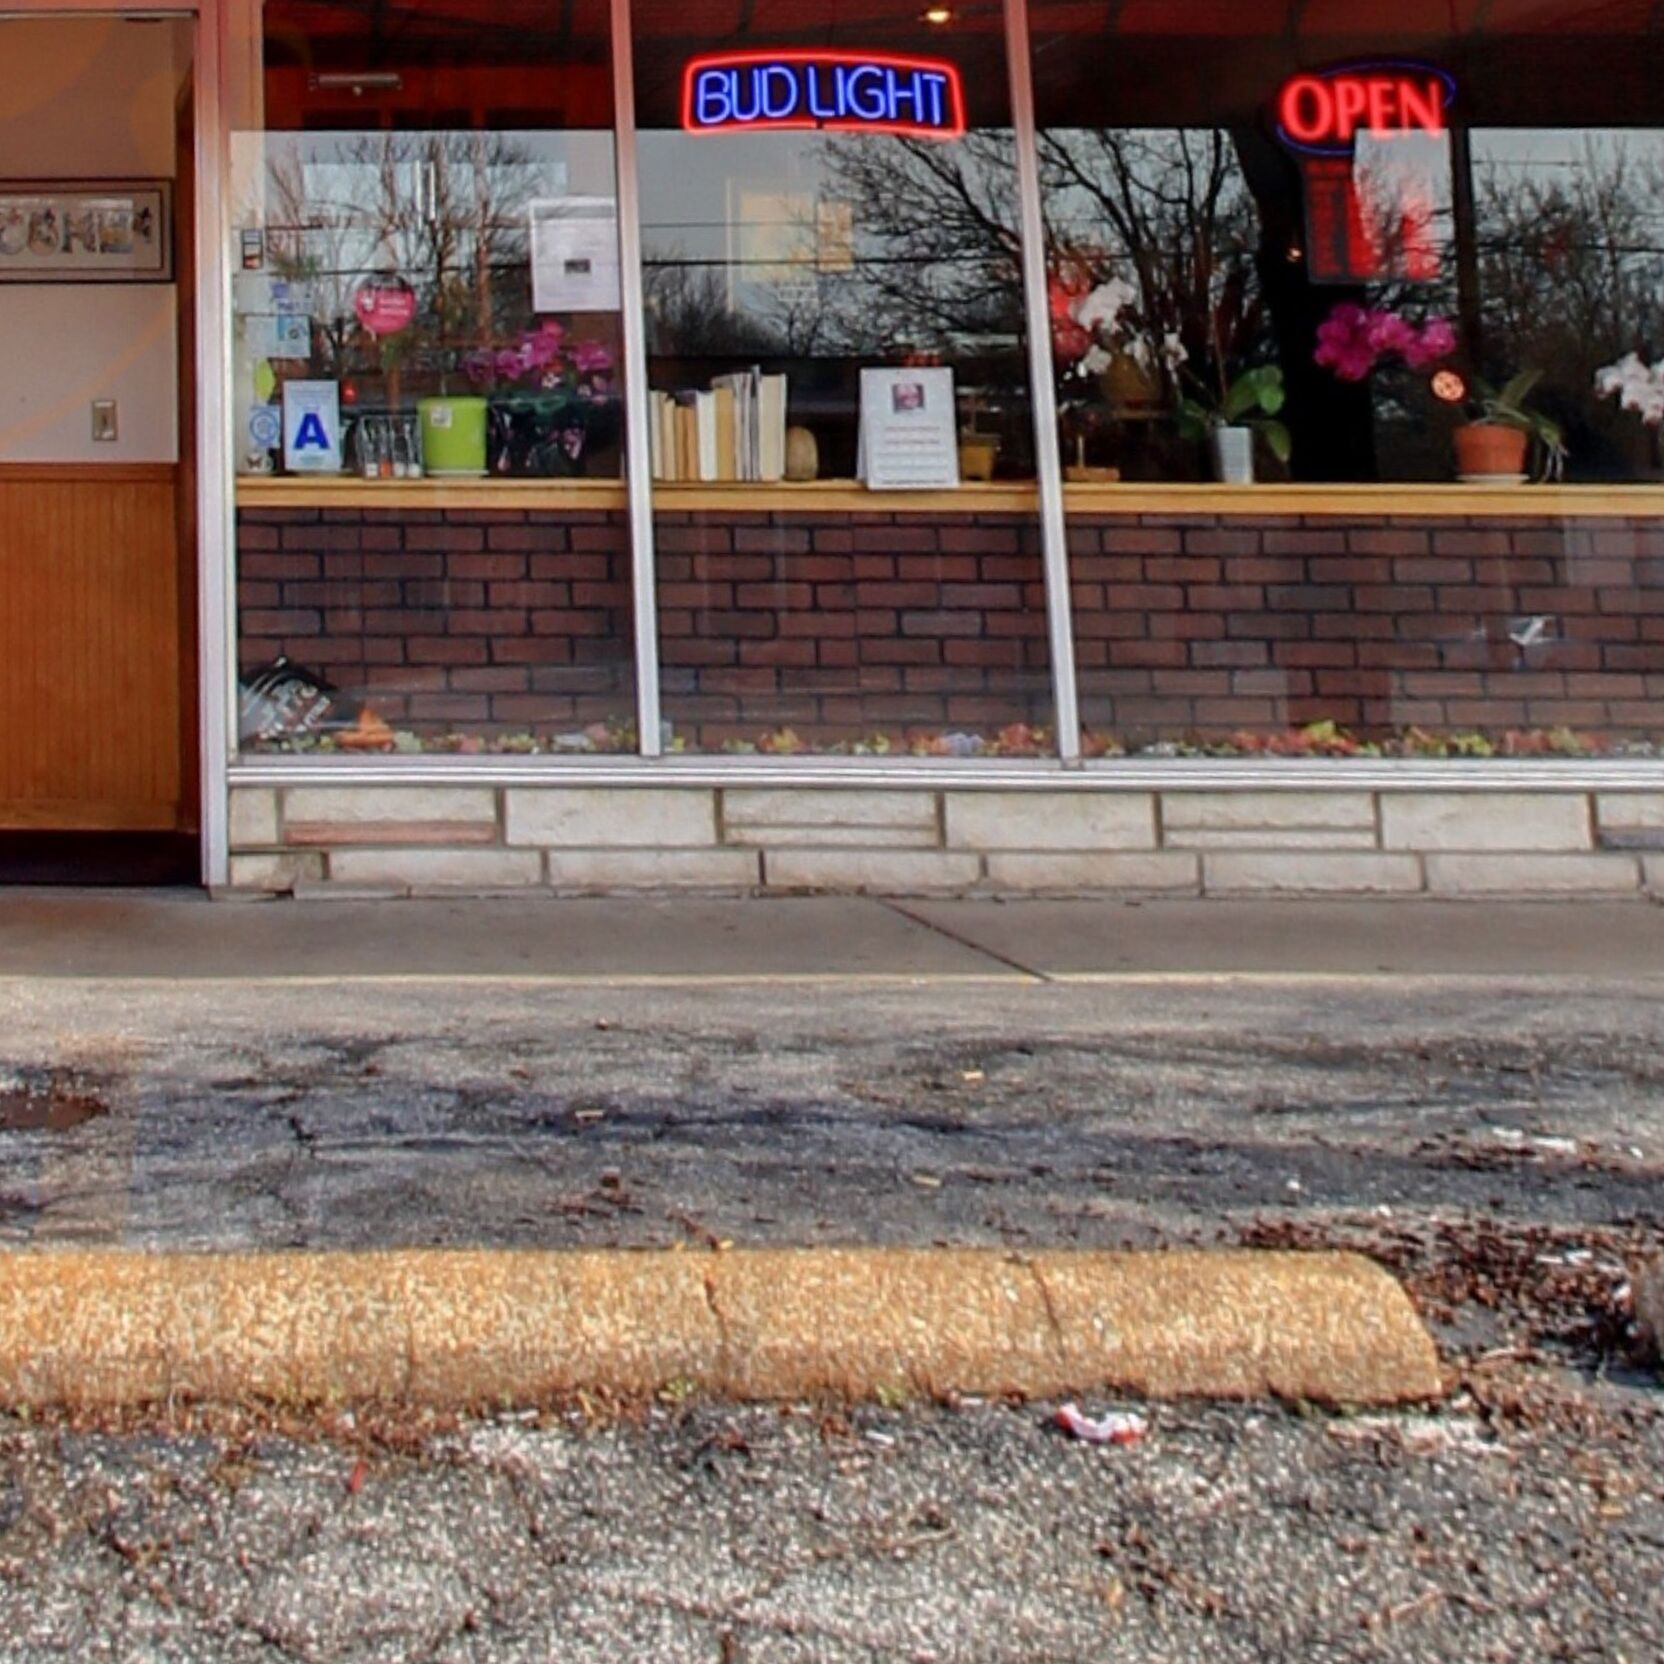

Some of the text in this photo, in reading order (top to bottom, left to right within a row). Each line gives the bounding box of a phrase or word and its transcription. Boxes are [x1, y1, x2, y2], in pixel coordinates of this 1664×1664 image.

[696, 64, 947, 127] BUD LIGHT
[1278, 77, 1448, 144] OPEN
[293, 412, 331, 450] A
